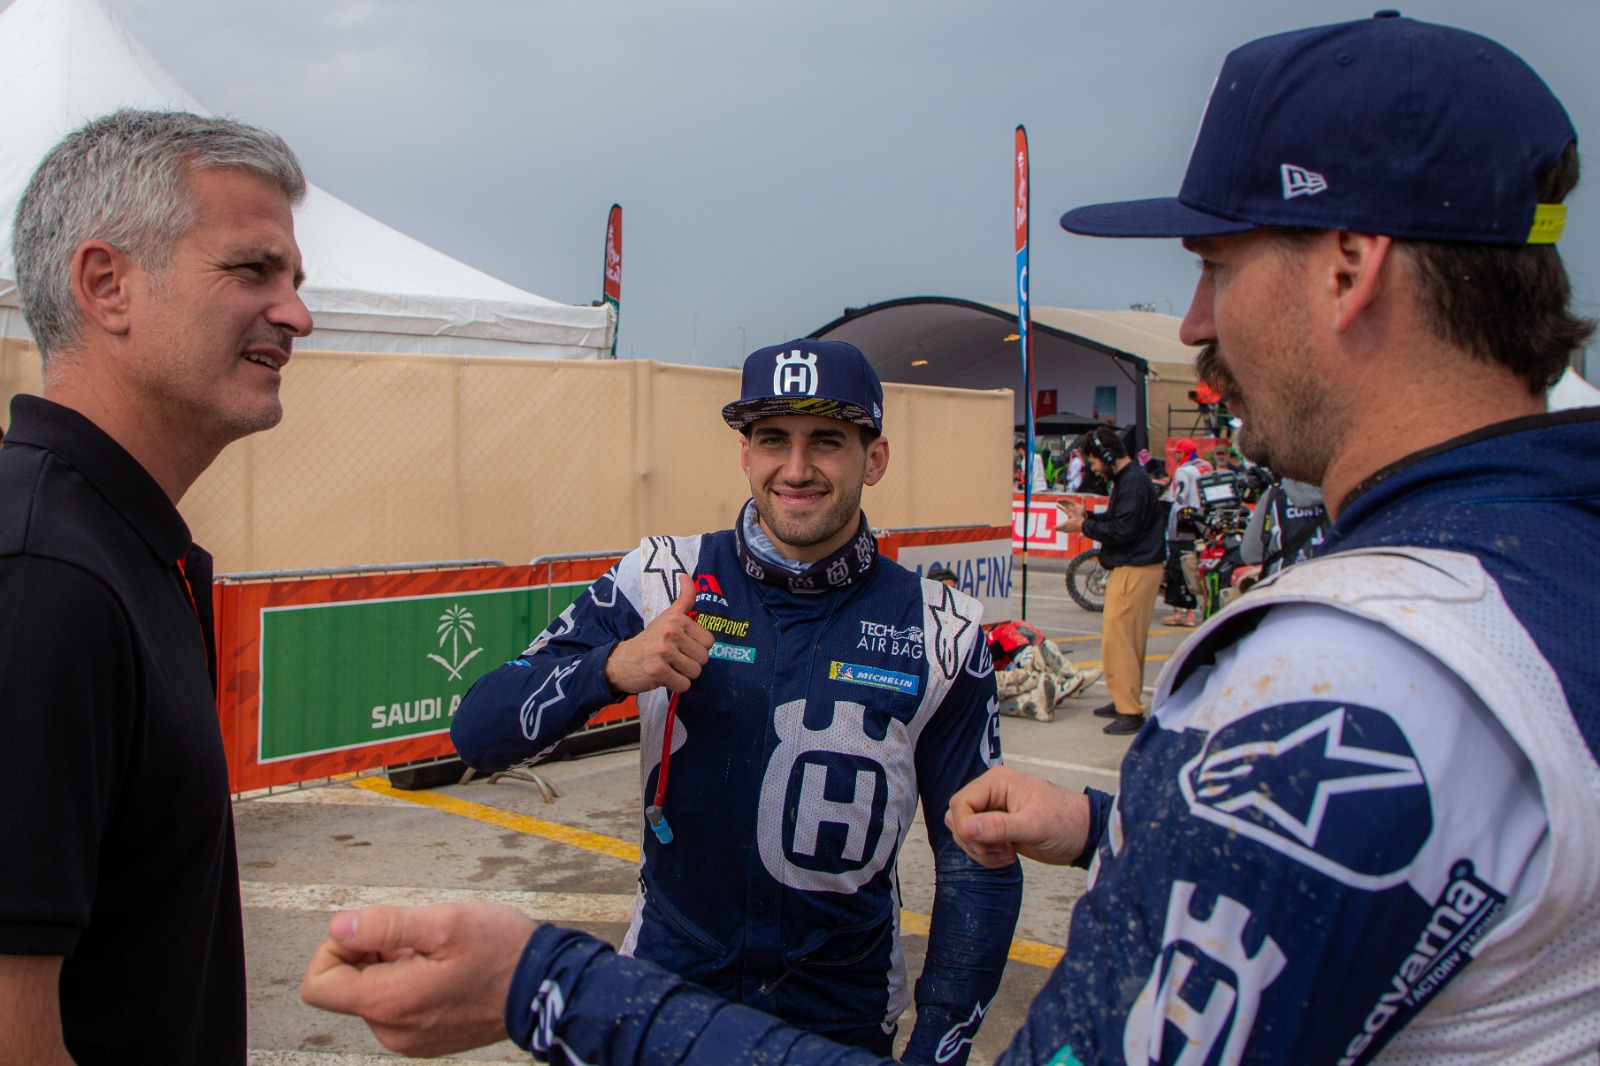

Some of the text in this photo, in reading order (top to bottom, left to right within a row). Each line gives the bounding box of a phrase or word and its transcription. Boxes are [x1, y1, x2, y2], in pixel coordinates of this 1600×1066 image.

[1012, 511, 1052, 539] UL
[856, 635, 886, 653] AIR
[891, 640, 923, 660] BAG
[856, 671, 913, 688] MICHELIN
[371, 696, 442, 729] SAUDI
